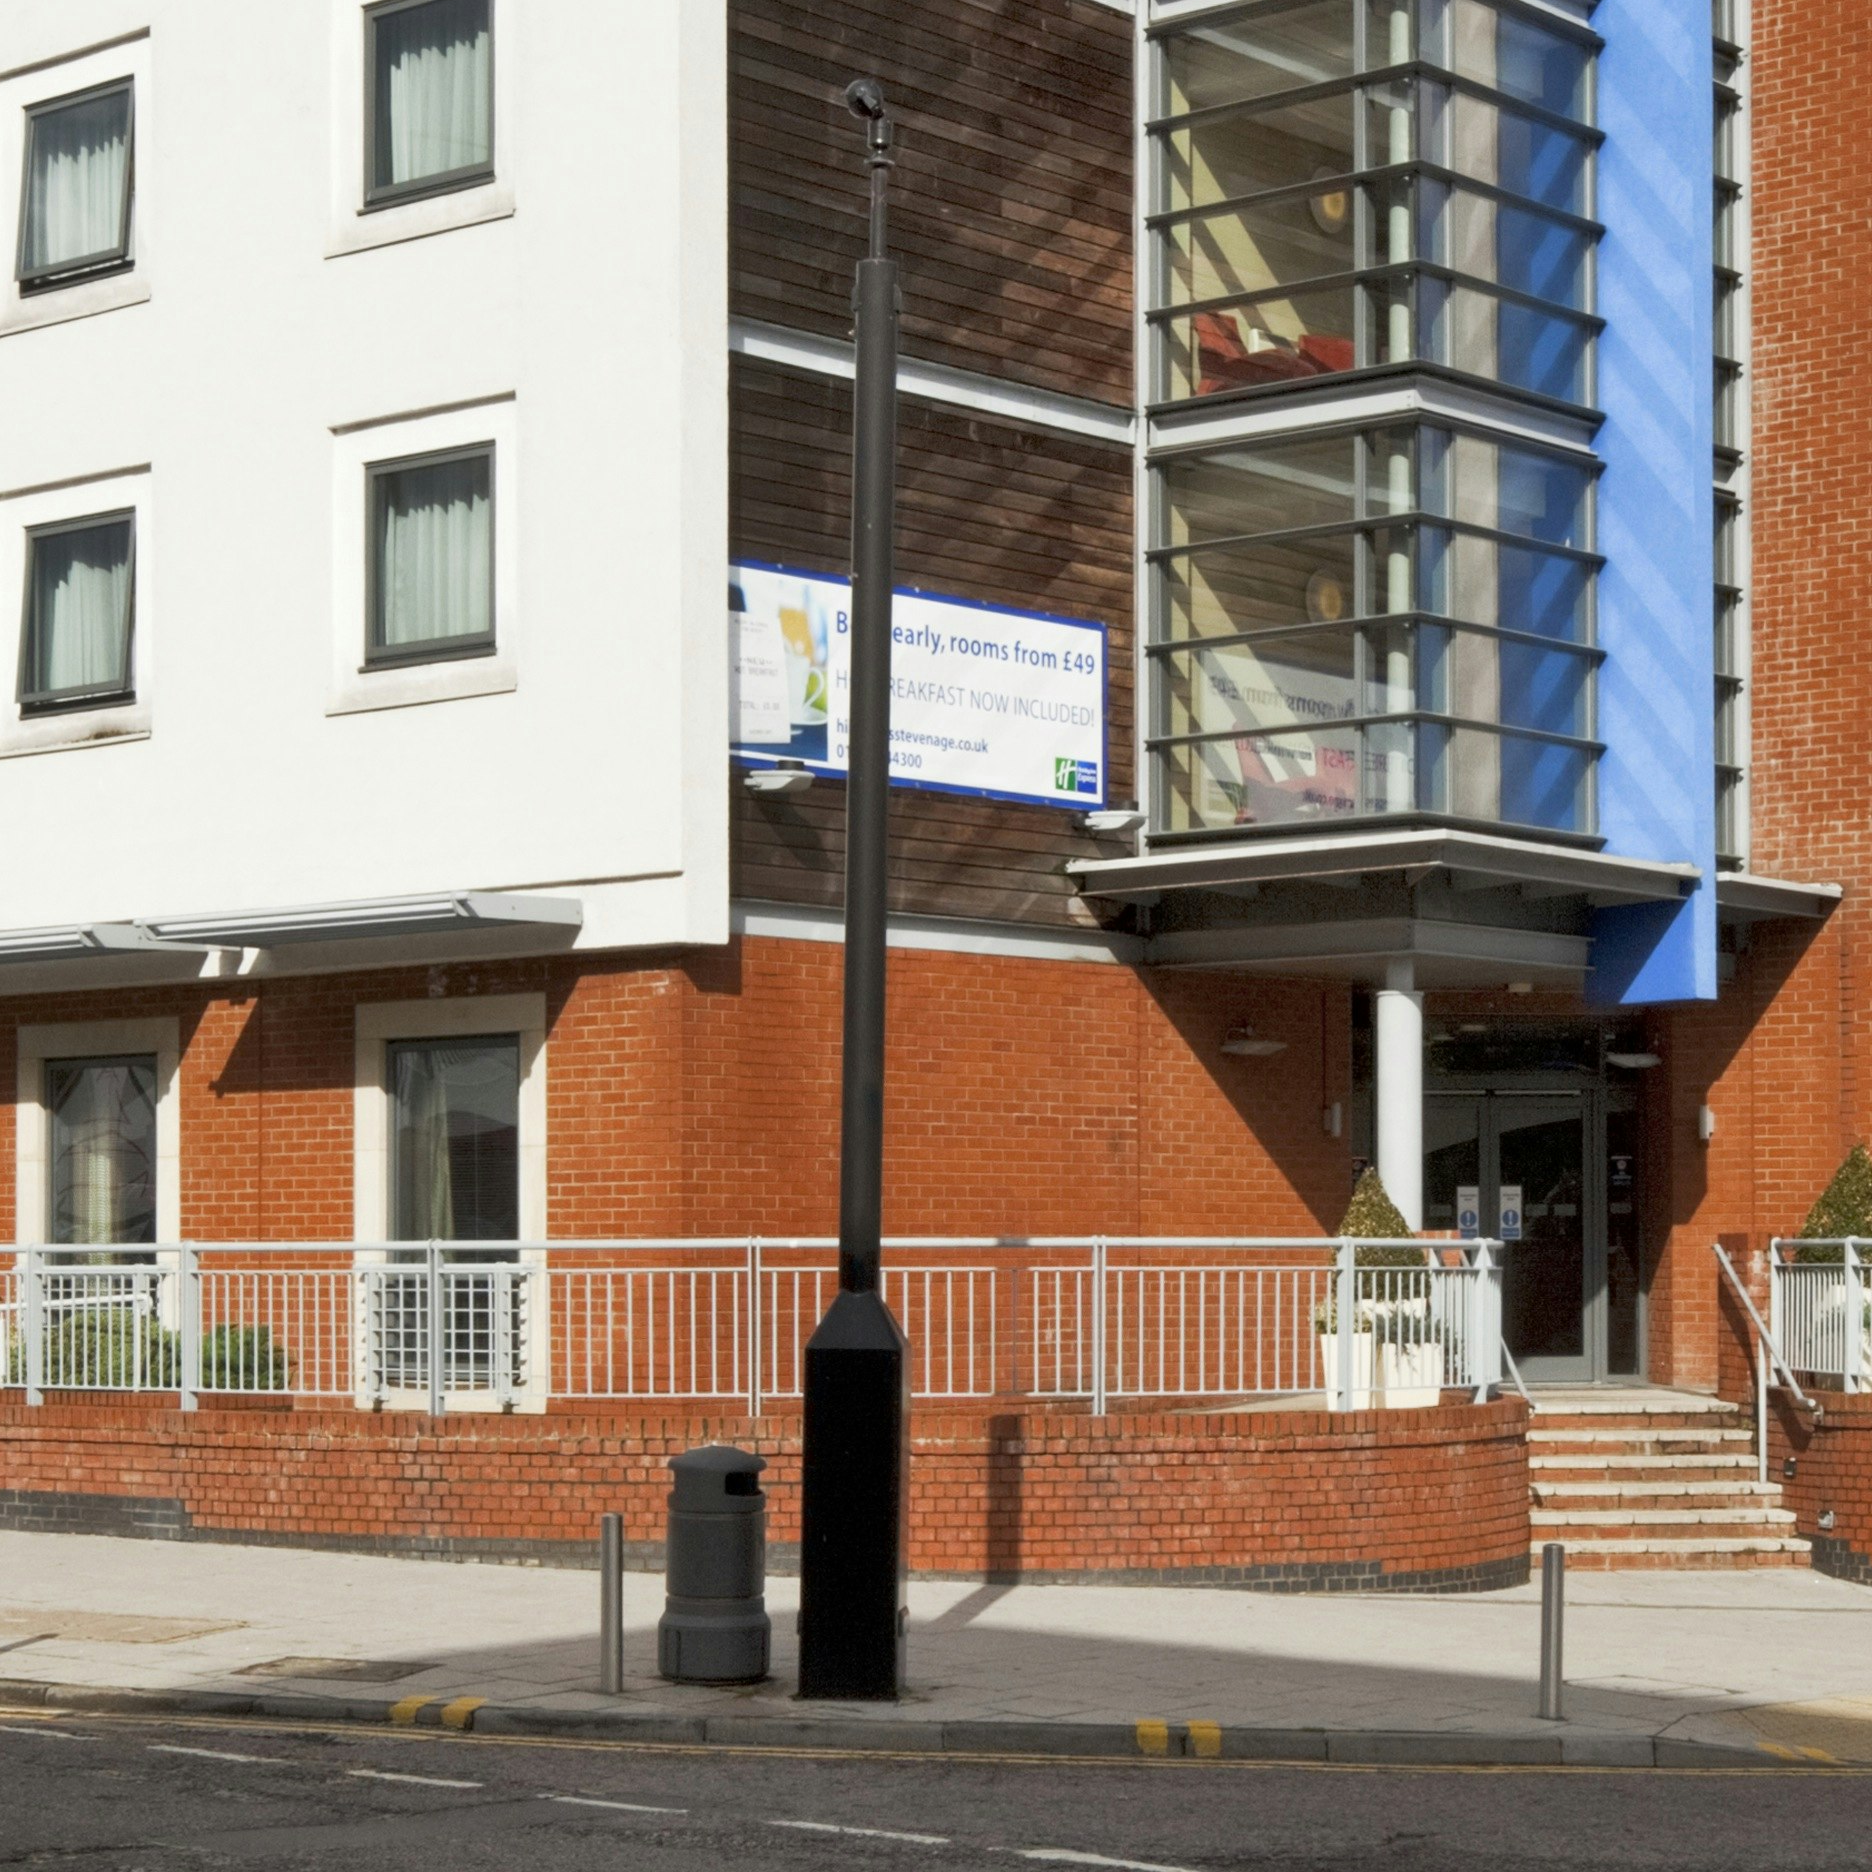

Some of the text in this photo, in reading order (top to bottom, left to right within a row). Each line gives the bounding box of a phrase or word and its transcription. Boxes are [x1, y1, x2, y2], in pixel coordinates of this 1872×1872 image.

[891, 624, 1095, 675] early, rooms from £49
[889, 676, 1095, 727] REAKFAST NOW INCLUDED!
